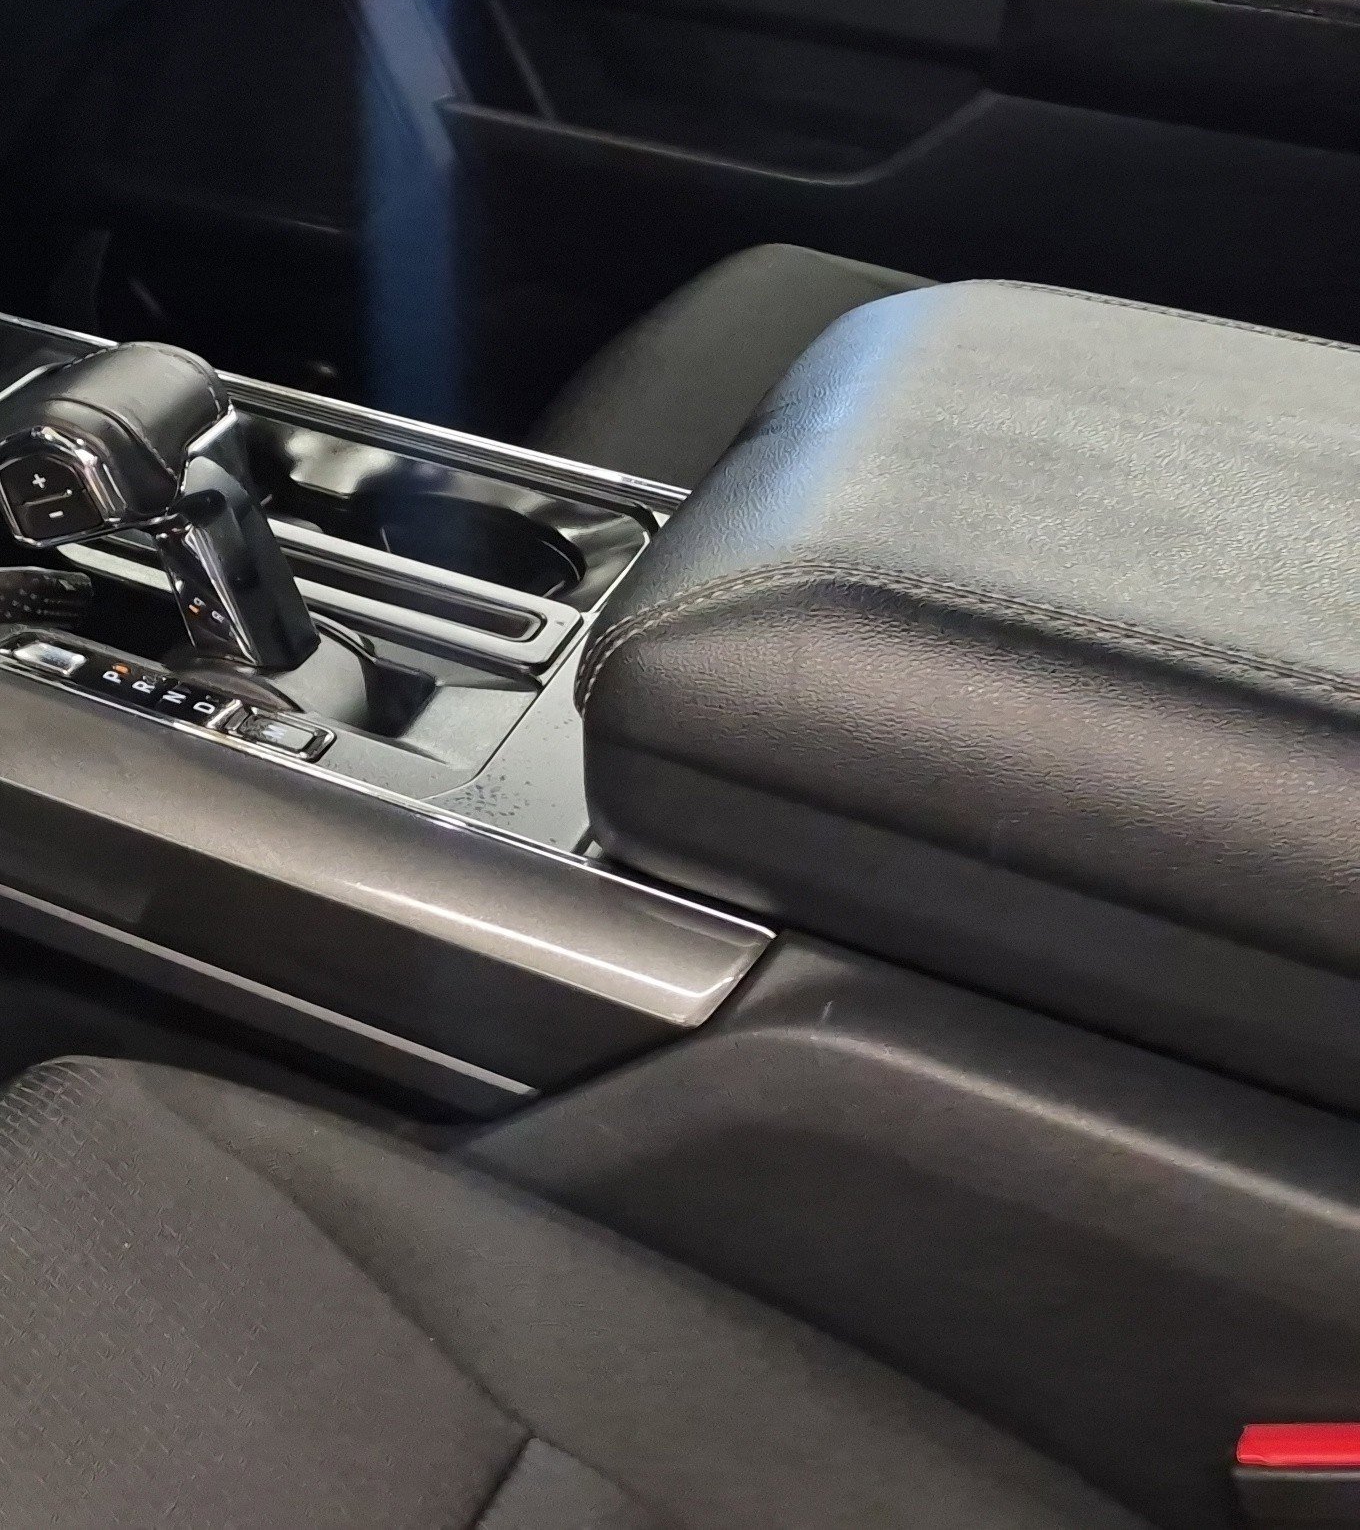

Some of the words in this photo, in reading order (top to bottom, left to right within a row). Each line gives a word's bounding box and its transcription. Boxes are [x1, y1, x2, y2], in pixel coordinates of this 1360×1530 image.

[102, 670, 122, 684] P
[132, 679, 156, 694] R
[162, 689, 187, 704] N
[193, 701, 216, 715] D
